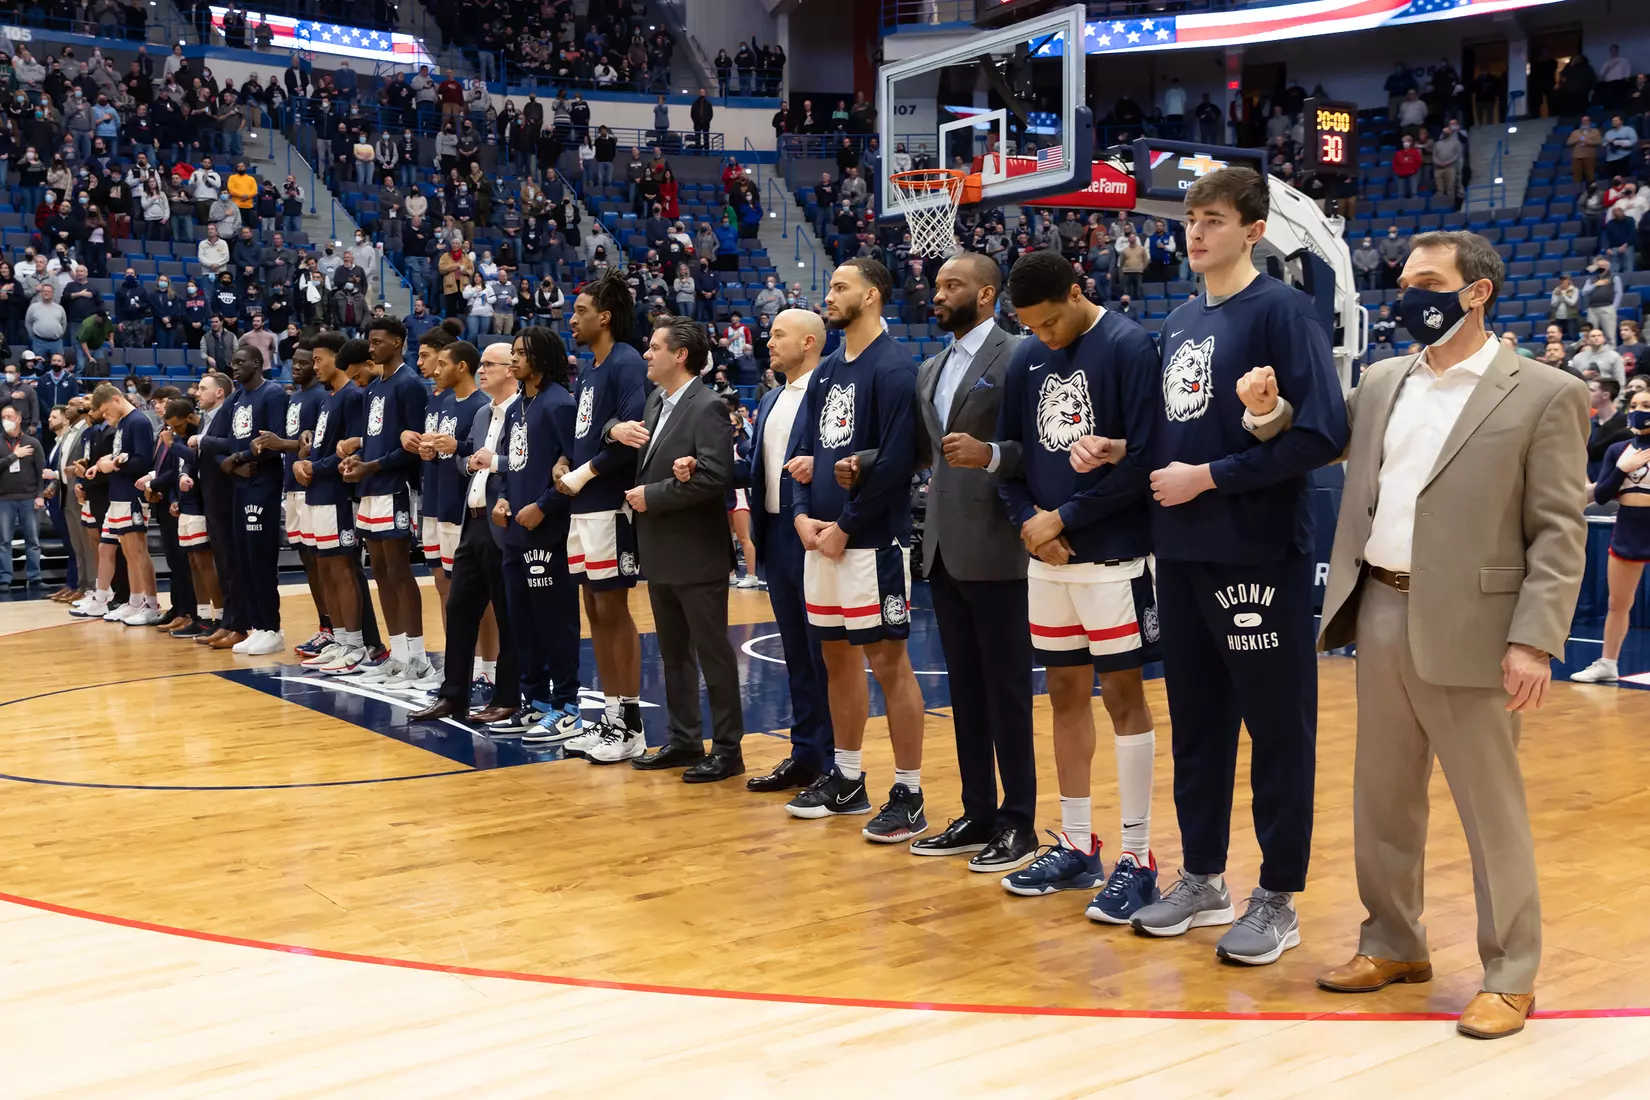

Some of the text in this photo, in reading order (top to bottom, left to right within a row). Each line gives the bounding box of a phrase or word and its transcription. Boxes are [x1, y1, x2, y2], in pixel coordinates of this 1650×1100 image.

[1322, 134, 1343, 162] 30
[523, 548, 553, 564] UCONN
[1214, 583, 1276, 609] UCONN
[1226, 631, 1279, 651] HUSKIES
